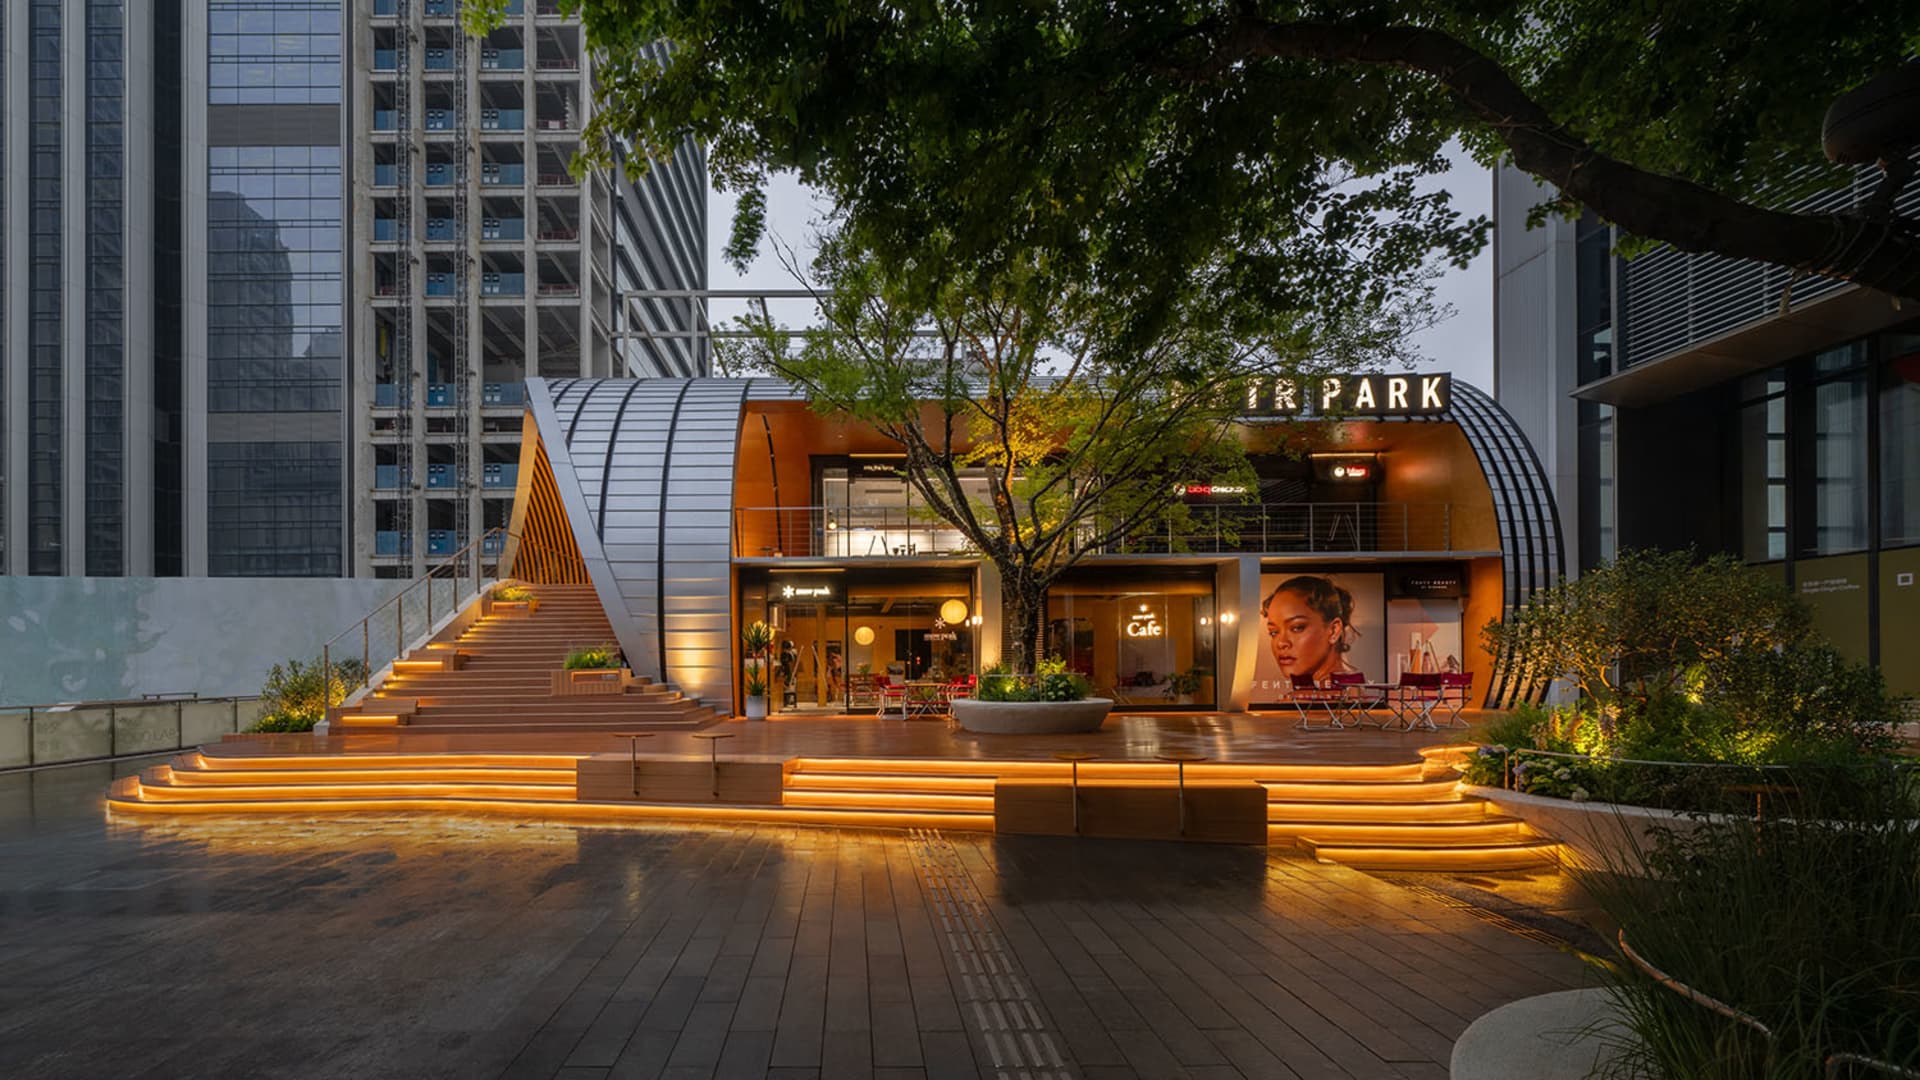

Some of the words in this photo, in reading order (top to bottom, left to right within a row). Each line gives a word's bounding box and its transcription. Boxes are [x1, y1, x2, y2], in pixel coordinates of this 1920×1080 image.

[1322, 377, 1442, 409] PARK
[1127, 620, 1162, 637] Cafe
[1251, 680, 1291, 690] FENT
